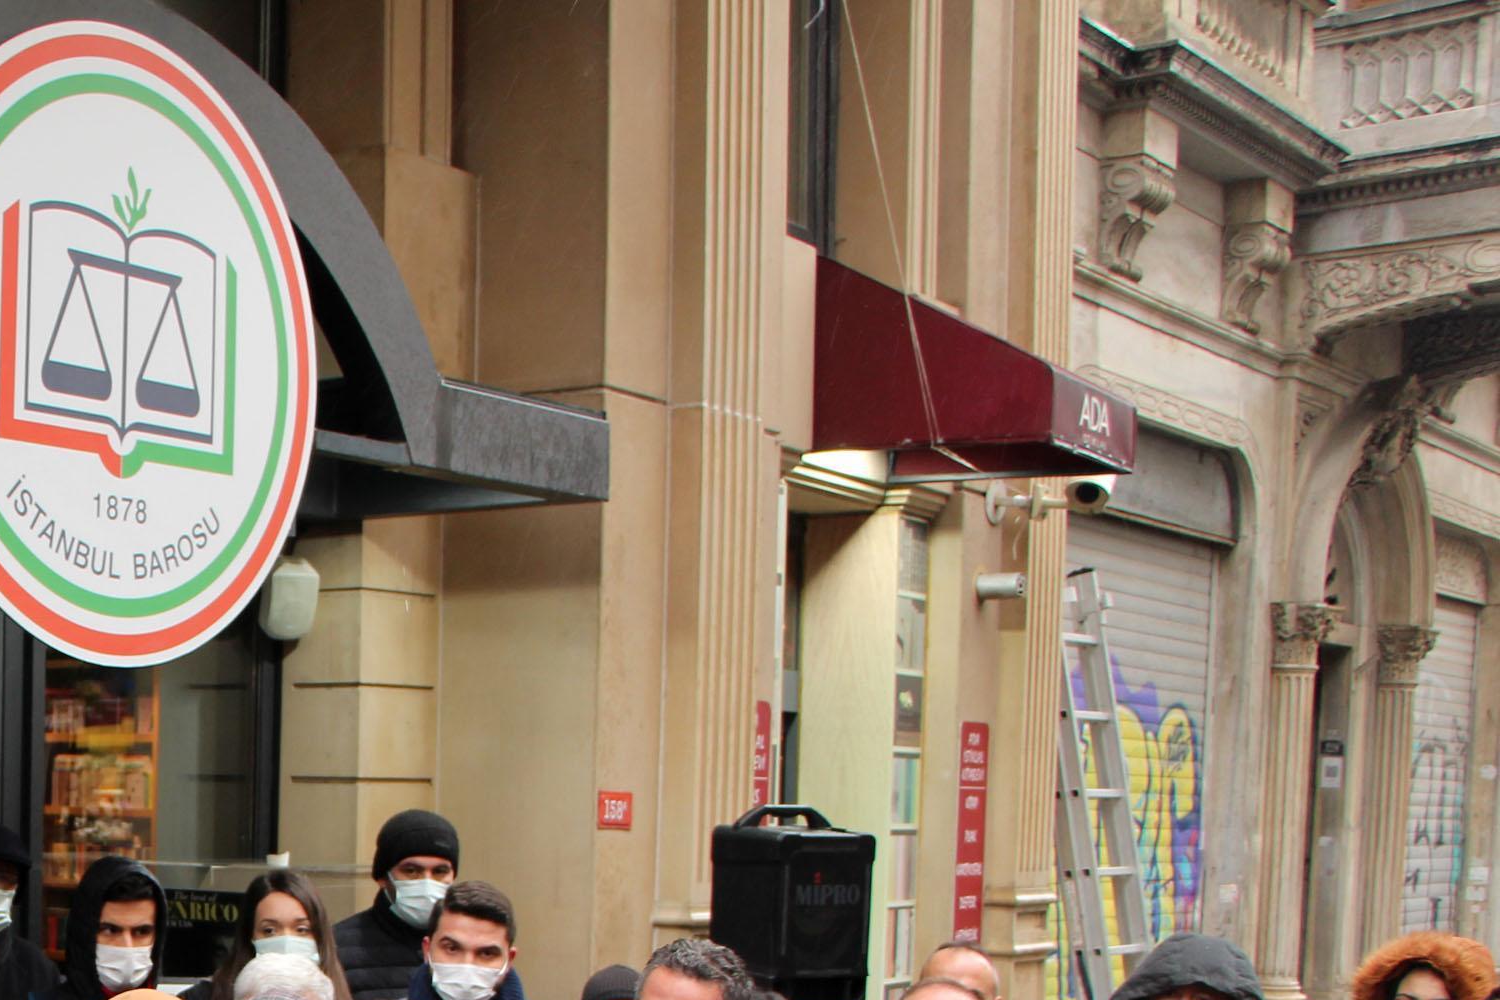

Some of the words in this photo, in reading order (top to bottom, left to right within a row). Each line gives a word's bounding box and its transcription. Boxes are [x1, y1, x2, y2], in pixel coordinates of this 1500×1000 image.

[1079, 393, 1110, 437] ADA
[6, 474, 121, 580] İSTANBUL
[132, 507, 221, 580] BAROSU
[93, 493, 148, 524] 1878
